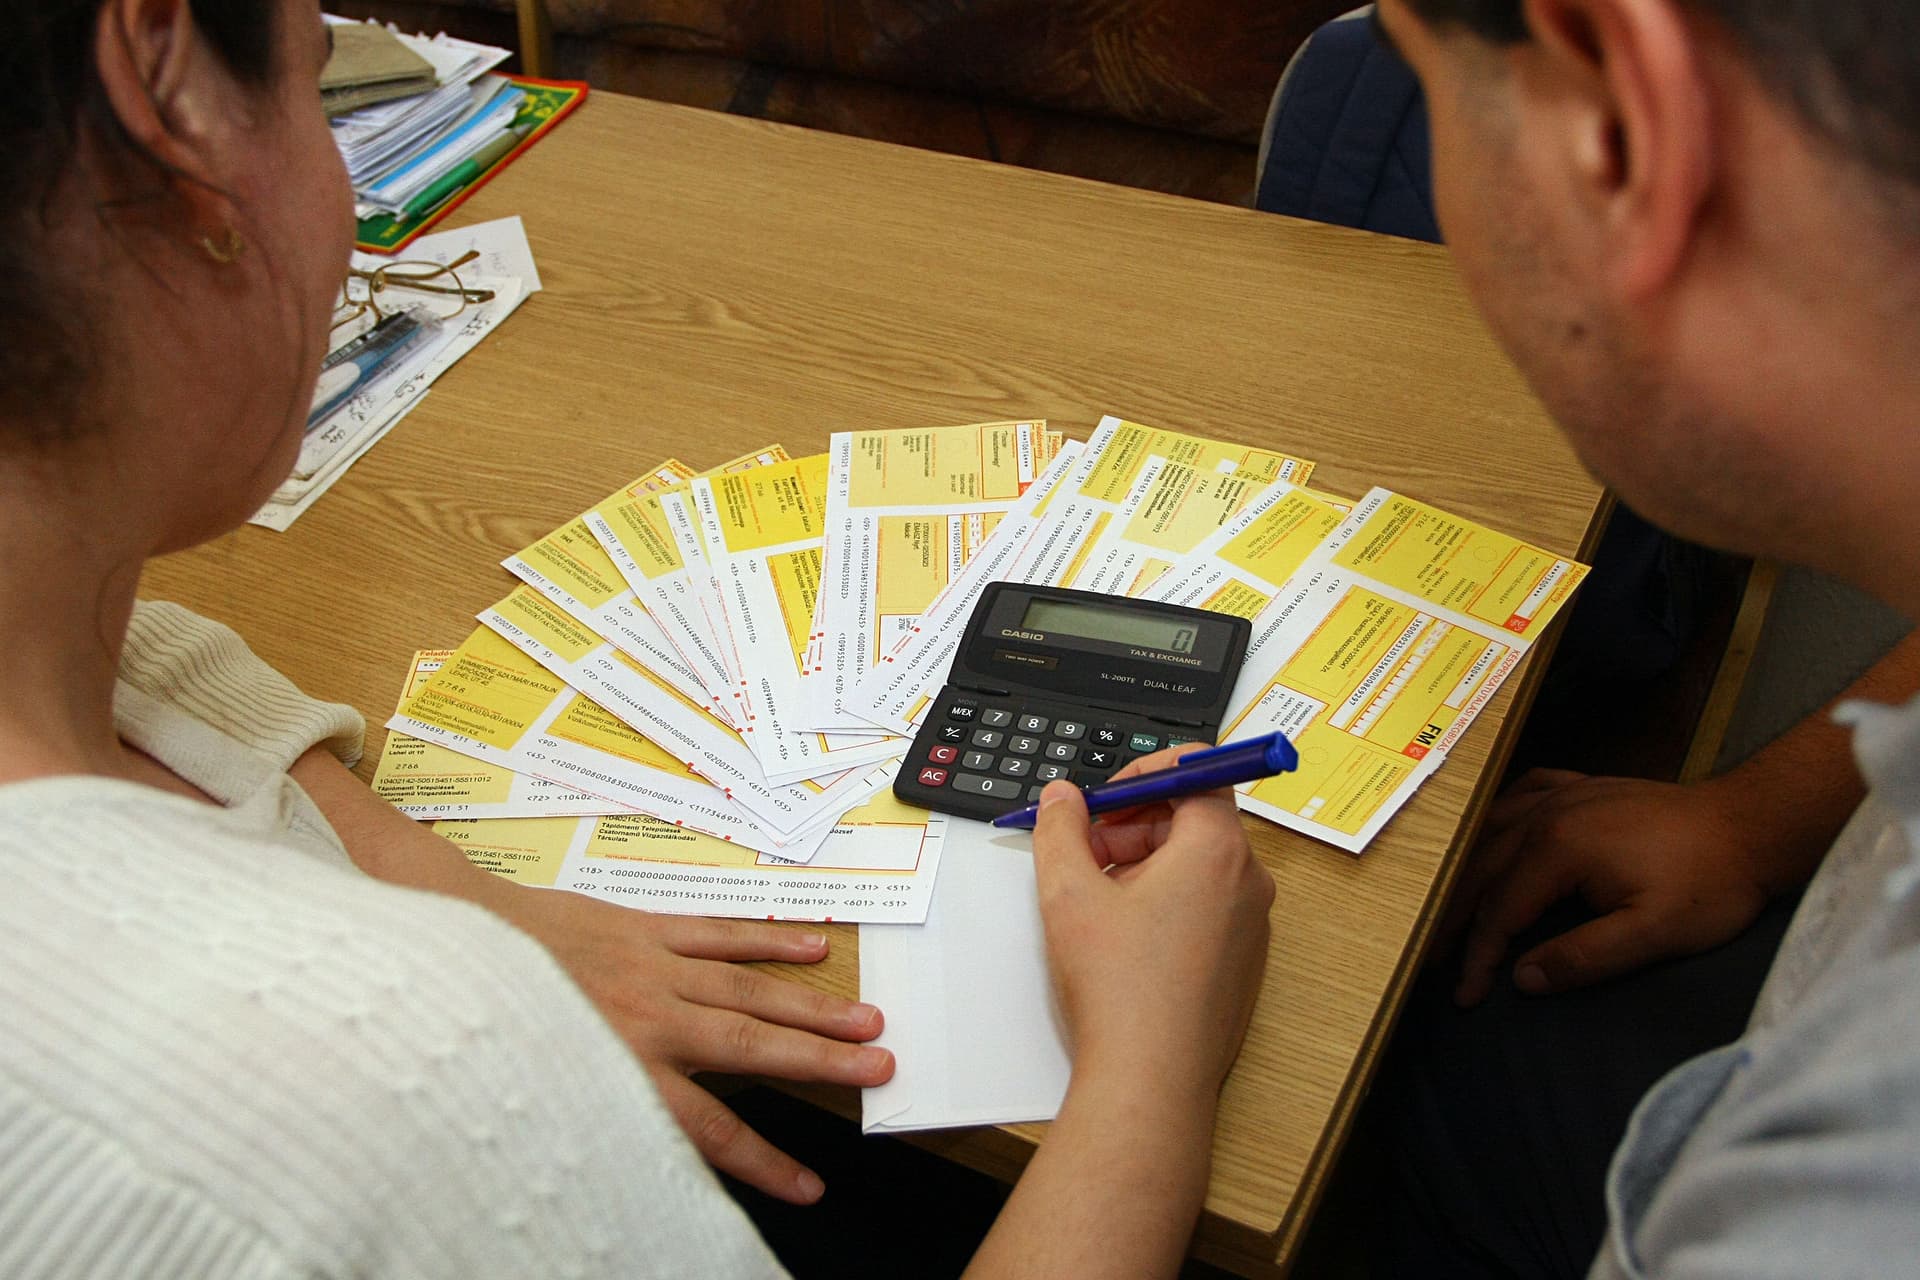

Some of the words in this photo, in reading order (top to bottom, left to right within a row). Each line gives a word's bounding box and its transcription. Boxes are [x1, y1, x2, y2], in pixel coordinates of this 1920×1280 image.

[1041, 480, 1052, 492] 611
[1012, 523, 1027, 540] <36>
[616, 547, 627, 559] 611
[1105, 547, 1119, 564] <72>
[1123, 552, 1137, 568] <18>
[747, 559, 757, 573] <36>
[1190, 561, 1207, 576] <45>
[1205, 569, 1222, 585] <90>
[1307, 570, 1323, 587] <18>
[654, 584, 668, 601] <72>
[672, 579, 686, 594] <72>
[1325, 577, 1340, 594] <18>
[548, 584, 561, 595] 611
[565, 596, 575, 605] 55
[617, 604, 634, 618] <72>
[602, 613, 618, 626] <27>
[1001, 628, 1043, 641] CASIO
[1169, 628, 1192, 650] 0
[524, 637, 539, 649] 611
[542, 649, 553, 659] 55
[906, 633, 939, 671] <02630407>
[597, 656, 614, 672] <72>
[729, 561, 738, 576] <63>
[761, 677, 776, 717] <00299969>
[773, 719, 782, 740] <677>
[778, 744, 788, 761] <55>
[1130, 648, 1146, 657] TAX
[1156, 651, 1202, 666] EXCHANGE
[887, 673, 905, 691] <611>
[1100, 672, 1135, 684] SL-200TE
[1143, 678, 1168, 690] DUAL
[1171, 682, 1196, 694] LEAF
[906, 683, 920, 698] <31>
[1260, 688, 1278, 706] 2766
[873, 694, 887, 709] <51>
[890, 701, 904, 716] <51>
[951, 706, 972, 717] M/EX
[992, 712, 1001, 722] 7
[1028, 718, 1037, 728] 8
[1064, 724, 1074, 734] 9
[452, 733, 468, 743] 611
[476, 741, 487, 749] 54
[581, 666, 599, 682] <72>
[702, 749, 745, 782] <02003737>
[749, 781, 770, 799] <611>
[774, 799, 791, 813] <55>
[981, 733, 992, 743] 4
[1414, 720, 1442, 748] FM
[537, 737, 557, 748] <90>
[800, 740, 808, 757] <55>
[1019, 739, 1029, 749] 5
[1056, 745, 1066, 755] 6
[936, 749, 948, 758] C
[974, 755, 980, 764] 1
[1009, 761, 1019, 771] 2
[1046, 767, 1057, 777] 3
[921, 770, 943, 781] AC
[525, 750, 546, 761] <45>
[687, 802, 743, 825] <11734693>
[981, 780, 992, 791] 0
[790, 787, 808, 802] <55>
[597, 834, 628, 842] Társulata
[777, 880, 846, 889] <000002160>
[773, 896, 836, 905] <31868192>
